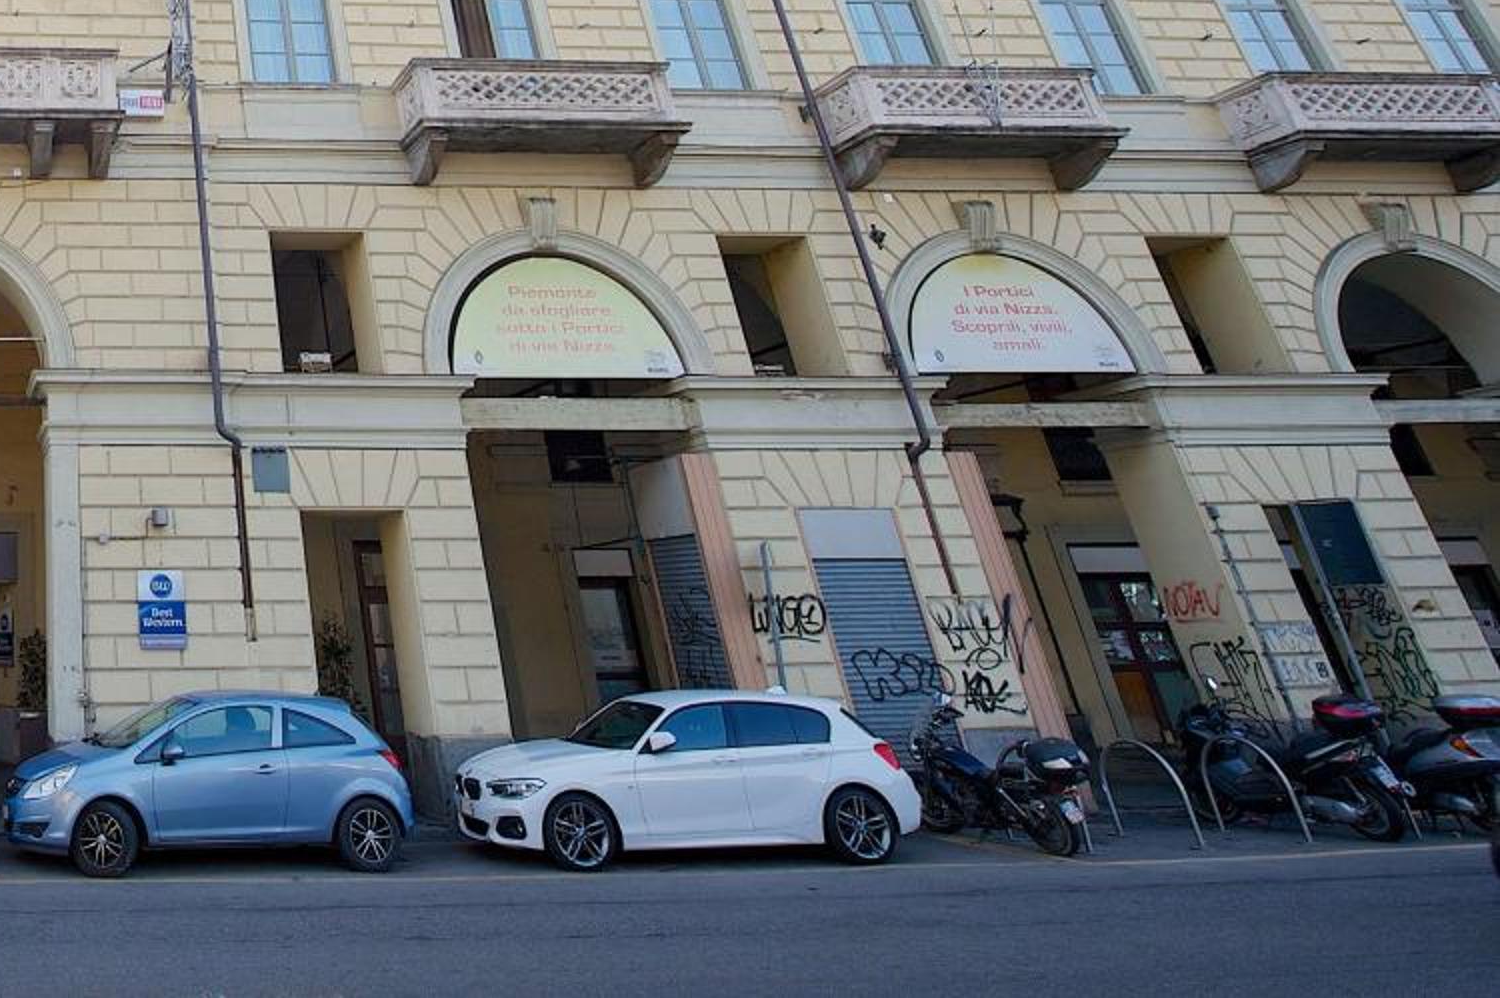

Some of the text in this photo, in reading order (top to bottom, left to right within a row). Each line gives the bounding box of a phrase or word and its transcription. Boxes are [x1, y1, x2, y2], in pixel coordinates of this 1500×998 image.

[508, 285, 596, 299] Piemonte
[974, 285, 1035, 298] Portici
[954, 303, 969, 316] di
[974, 305, 999, 316] via
[151, 607, 173, 618] Best
[142, 617, 184, 628] Western
